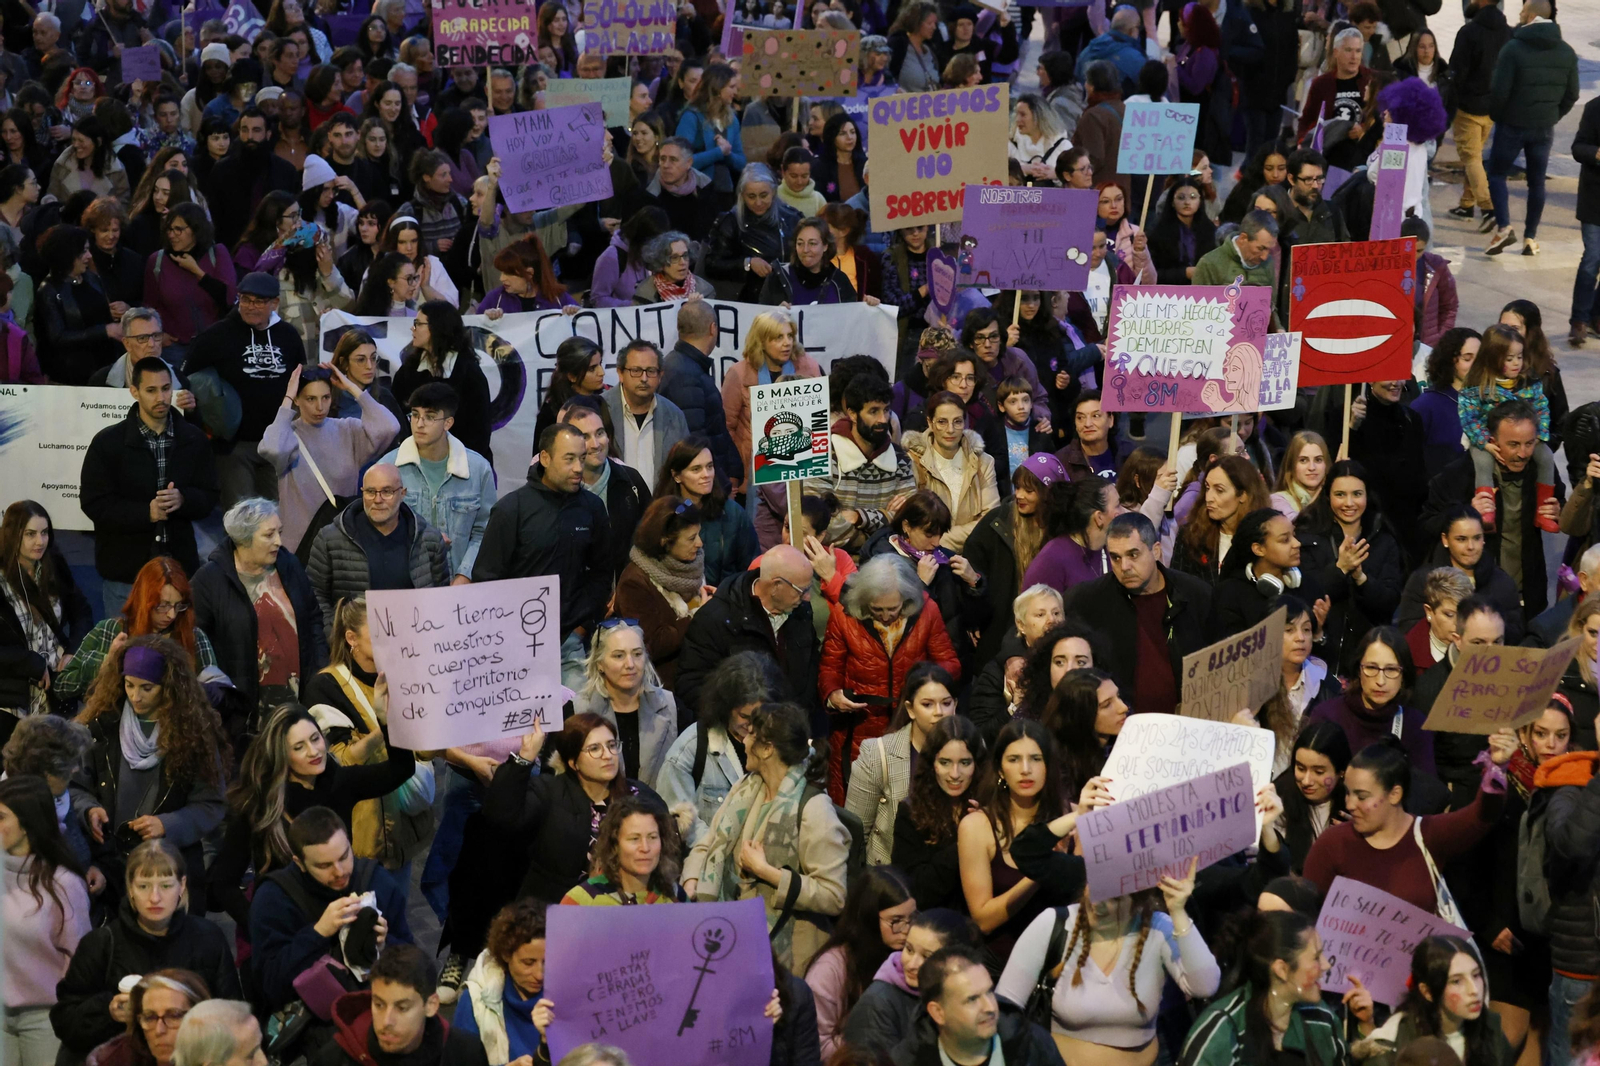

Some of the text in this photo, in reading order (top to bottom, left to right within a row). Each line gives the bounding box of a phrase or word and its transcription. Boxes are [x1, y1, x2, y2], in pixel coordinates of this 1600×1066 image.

[440, 16, 530, 34] AGRADECIDA
[585, 31, 675, 54] PALABRA
[437, 43, 539, 66] BENDECIDA
[872, 86, 1001, 126] QUEREMOS
[1131, 110, 1160, 127] NO
[506, 136, 525, 153] HOY
[531, 132, 553, 147] VOY
[1120, 133, 1186, 151] ESTAS
[520, 142, 579, 175] GRITAR
[916, 153, 952, 179] NO
[1128, 153, 1183, 171] SOLA
[549, 176, 610, 200] CALLAR
[980, 188, 1043, 204] NOSOTRAS
[1298, 246, 1310, 260] 8
[1122, 302, 1152, 319] QUE
[1156, 303, 1179, 319] MIS
[1182, 304, 1228, 323] HECHOS
[535, 303, 739, 359] CONTA
[1121, 319, 1194, 338] PALABRAS
[1127, 337, 1213, 355] DEMUESTREN
[1137, 354, 1213, 380] QUE SOY
[757, 383, 823, 400] 8 MARZO
[1144, 381, 1179, 407] 8M
[1275, 377, 1291, 391] LA
[80, 402, 117, 410] Ayudamos
[769, 394, 822, 406] INTERNACIONAL
[790, 399, 823, 408] MUJER
[38, 442, 75, 450] Luchamos
[811, 409, 829, 476] PALESTINA
[781, 468, 814, 480] FREE
[41, 482, 78, 491] Apoyamos
[373, 603, 514, 638] Ni la tierra
[400, 630, 505, 659] ni nuestros
[1208, 625, 1267, 672] RESPETO
[428, 651, 504, 677] cuerpos
[1464, 654, 1502, 675] NO
[400, 667, 531, 696] son territorio
[1452, 679, 1509, 702] PERRO
[402, 701, 428, 720] de
[503, 706, 546, 729] #8M
[1116, 754, 1140, 779] QUE
[1086, 810, 1114, 838] LES
[1126, 782, 1199, 824] MOLESTA
[1214, 767, 1244, 794] MAS
[1092, 843, 1113, 864] EL
[1132, 835, 1195, 871] QUE LOS
[1390, 910, 1410, 925] DE
[630, 951, 651, 963] HAY
[596, 962, 649, 984] PUERTAS
[587, 971, 652, 1002] CERRADAS
[622, 983, 656, 1003] PERO
[593, 993, 664, 1026] TENEMOS
[590, 1009, 658, 1040] LA LLAVE
